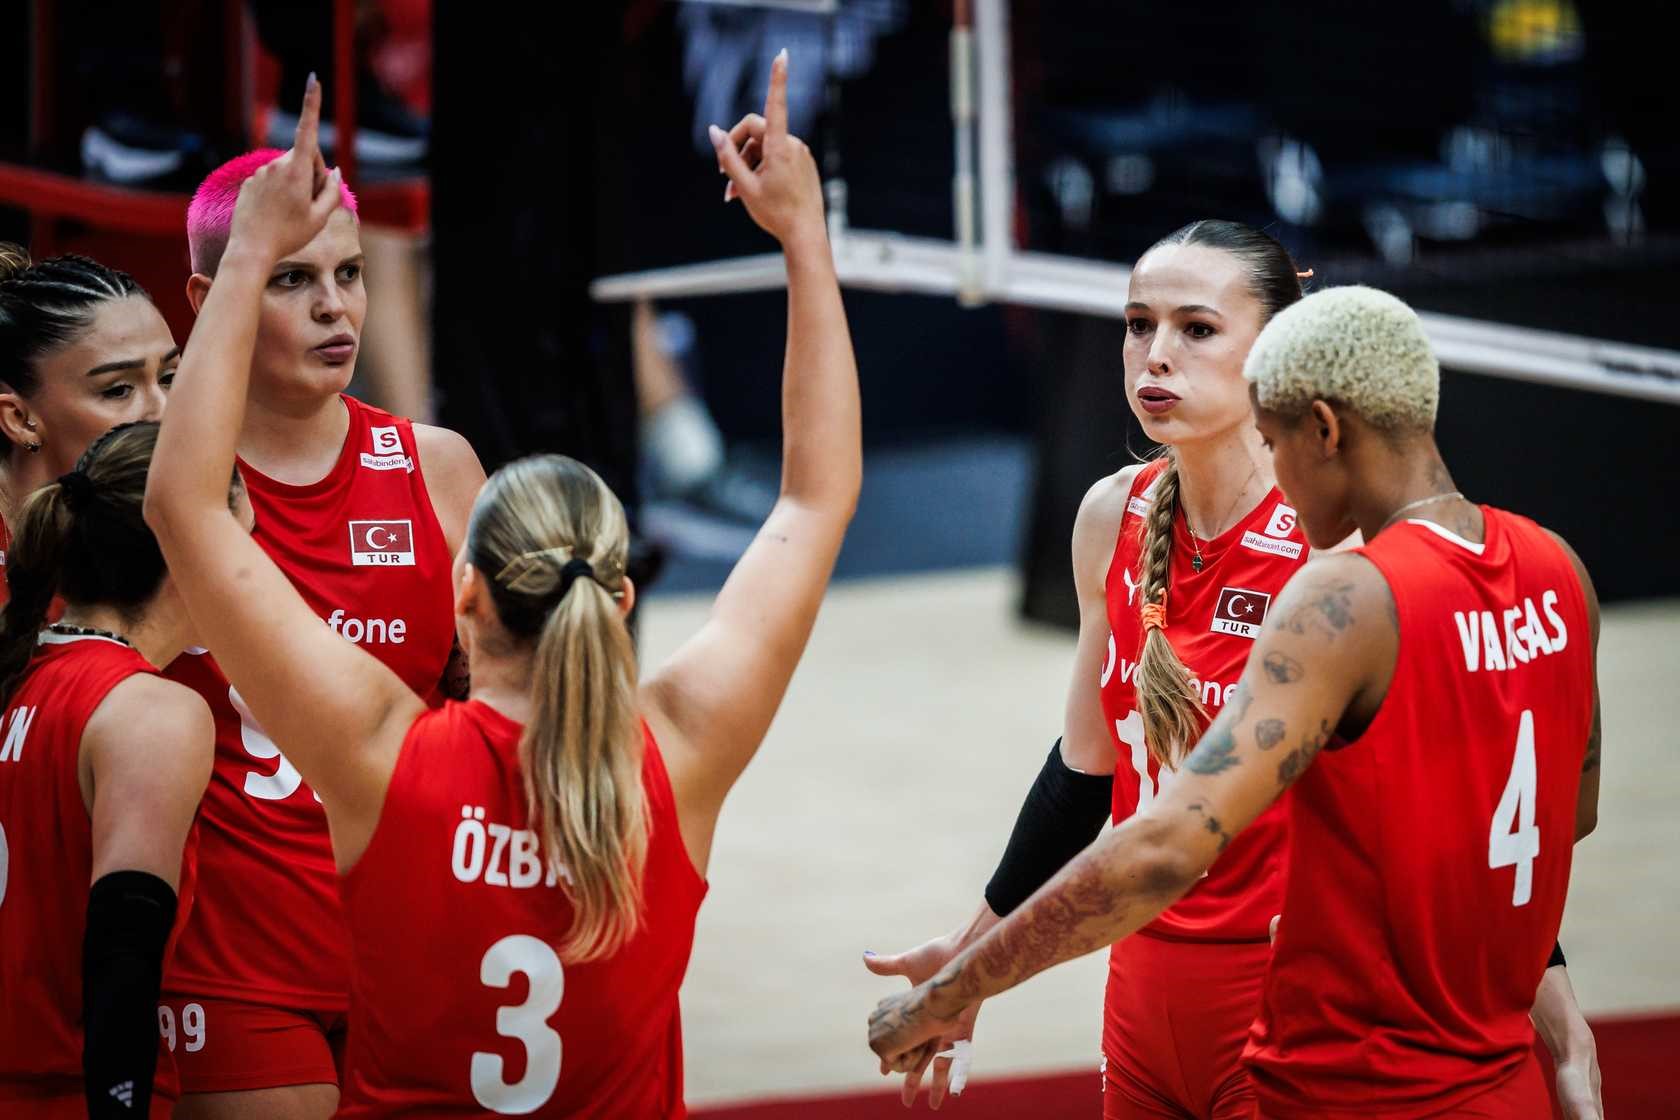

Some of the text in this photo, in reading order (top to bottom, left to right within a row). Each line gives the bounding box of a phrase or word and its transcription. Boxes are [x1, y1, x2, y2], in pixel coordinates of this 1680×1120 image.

[380, 432, 397, 447] S
[1276, 513, 1296, 531] S
[368, 554, 400, 563] TUR
[1221, 621, 1250, 635] TUR
[1488, 709, 1540, 907] 4
[470, 933, 565, 1116] 3
